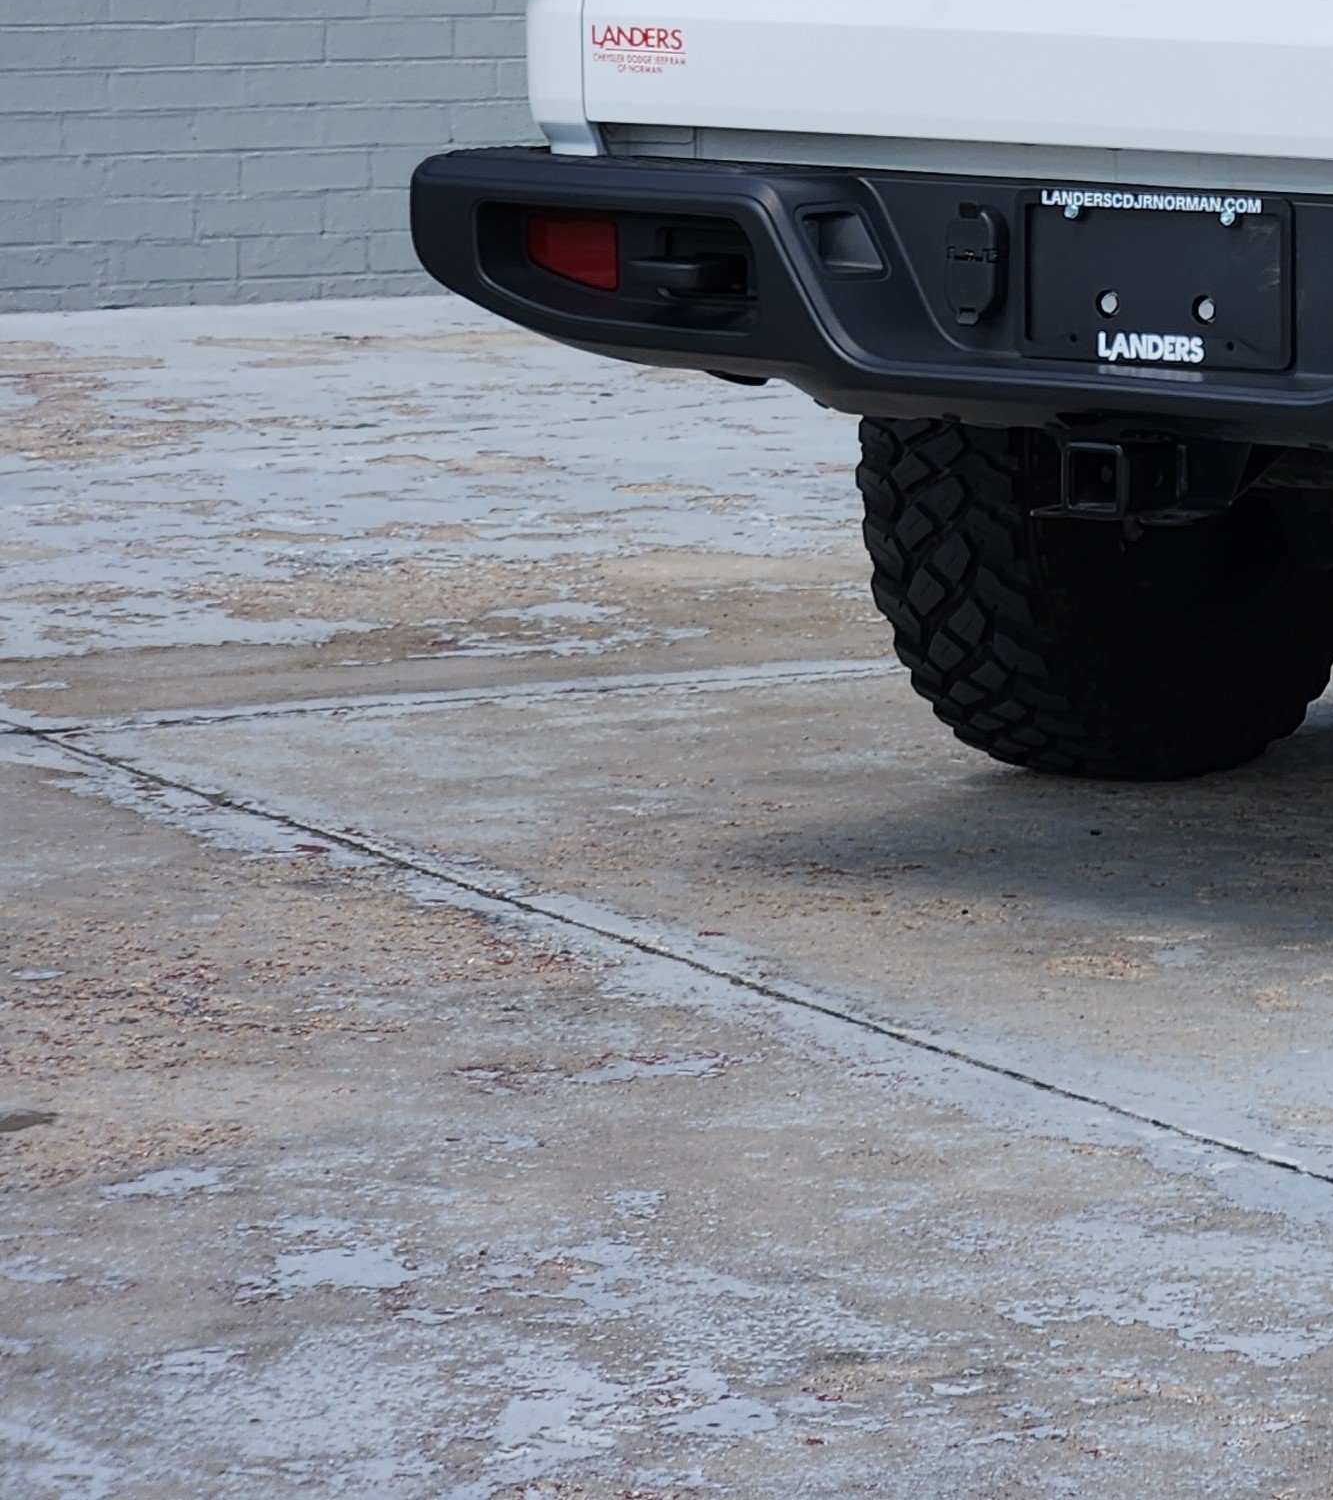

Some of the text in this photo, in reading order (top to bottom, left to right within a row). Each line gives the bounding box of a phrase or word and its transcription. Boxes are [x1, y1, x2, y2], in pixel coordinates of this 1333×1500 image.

[591, 25, 683, 50] LANDERS
[617, 64, 663, 74] OF NORMAN
[627, 54, 652, 65] DODGE
[1041, 189, 1262, 214] LANDERSCDJRNORMAN.COM
[1097, 330, 1205, 364] LANDERS
